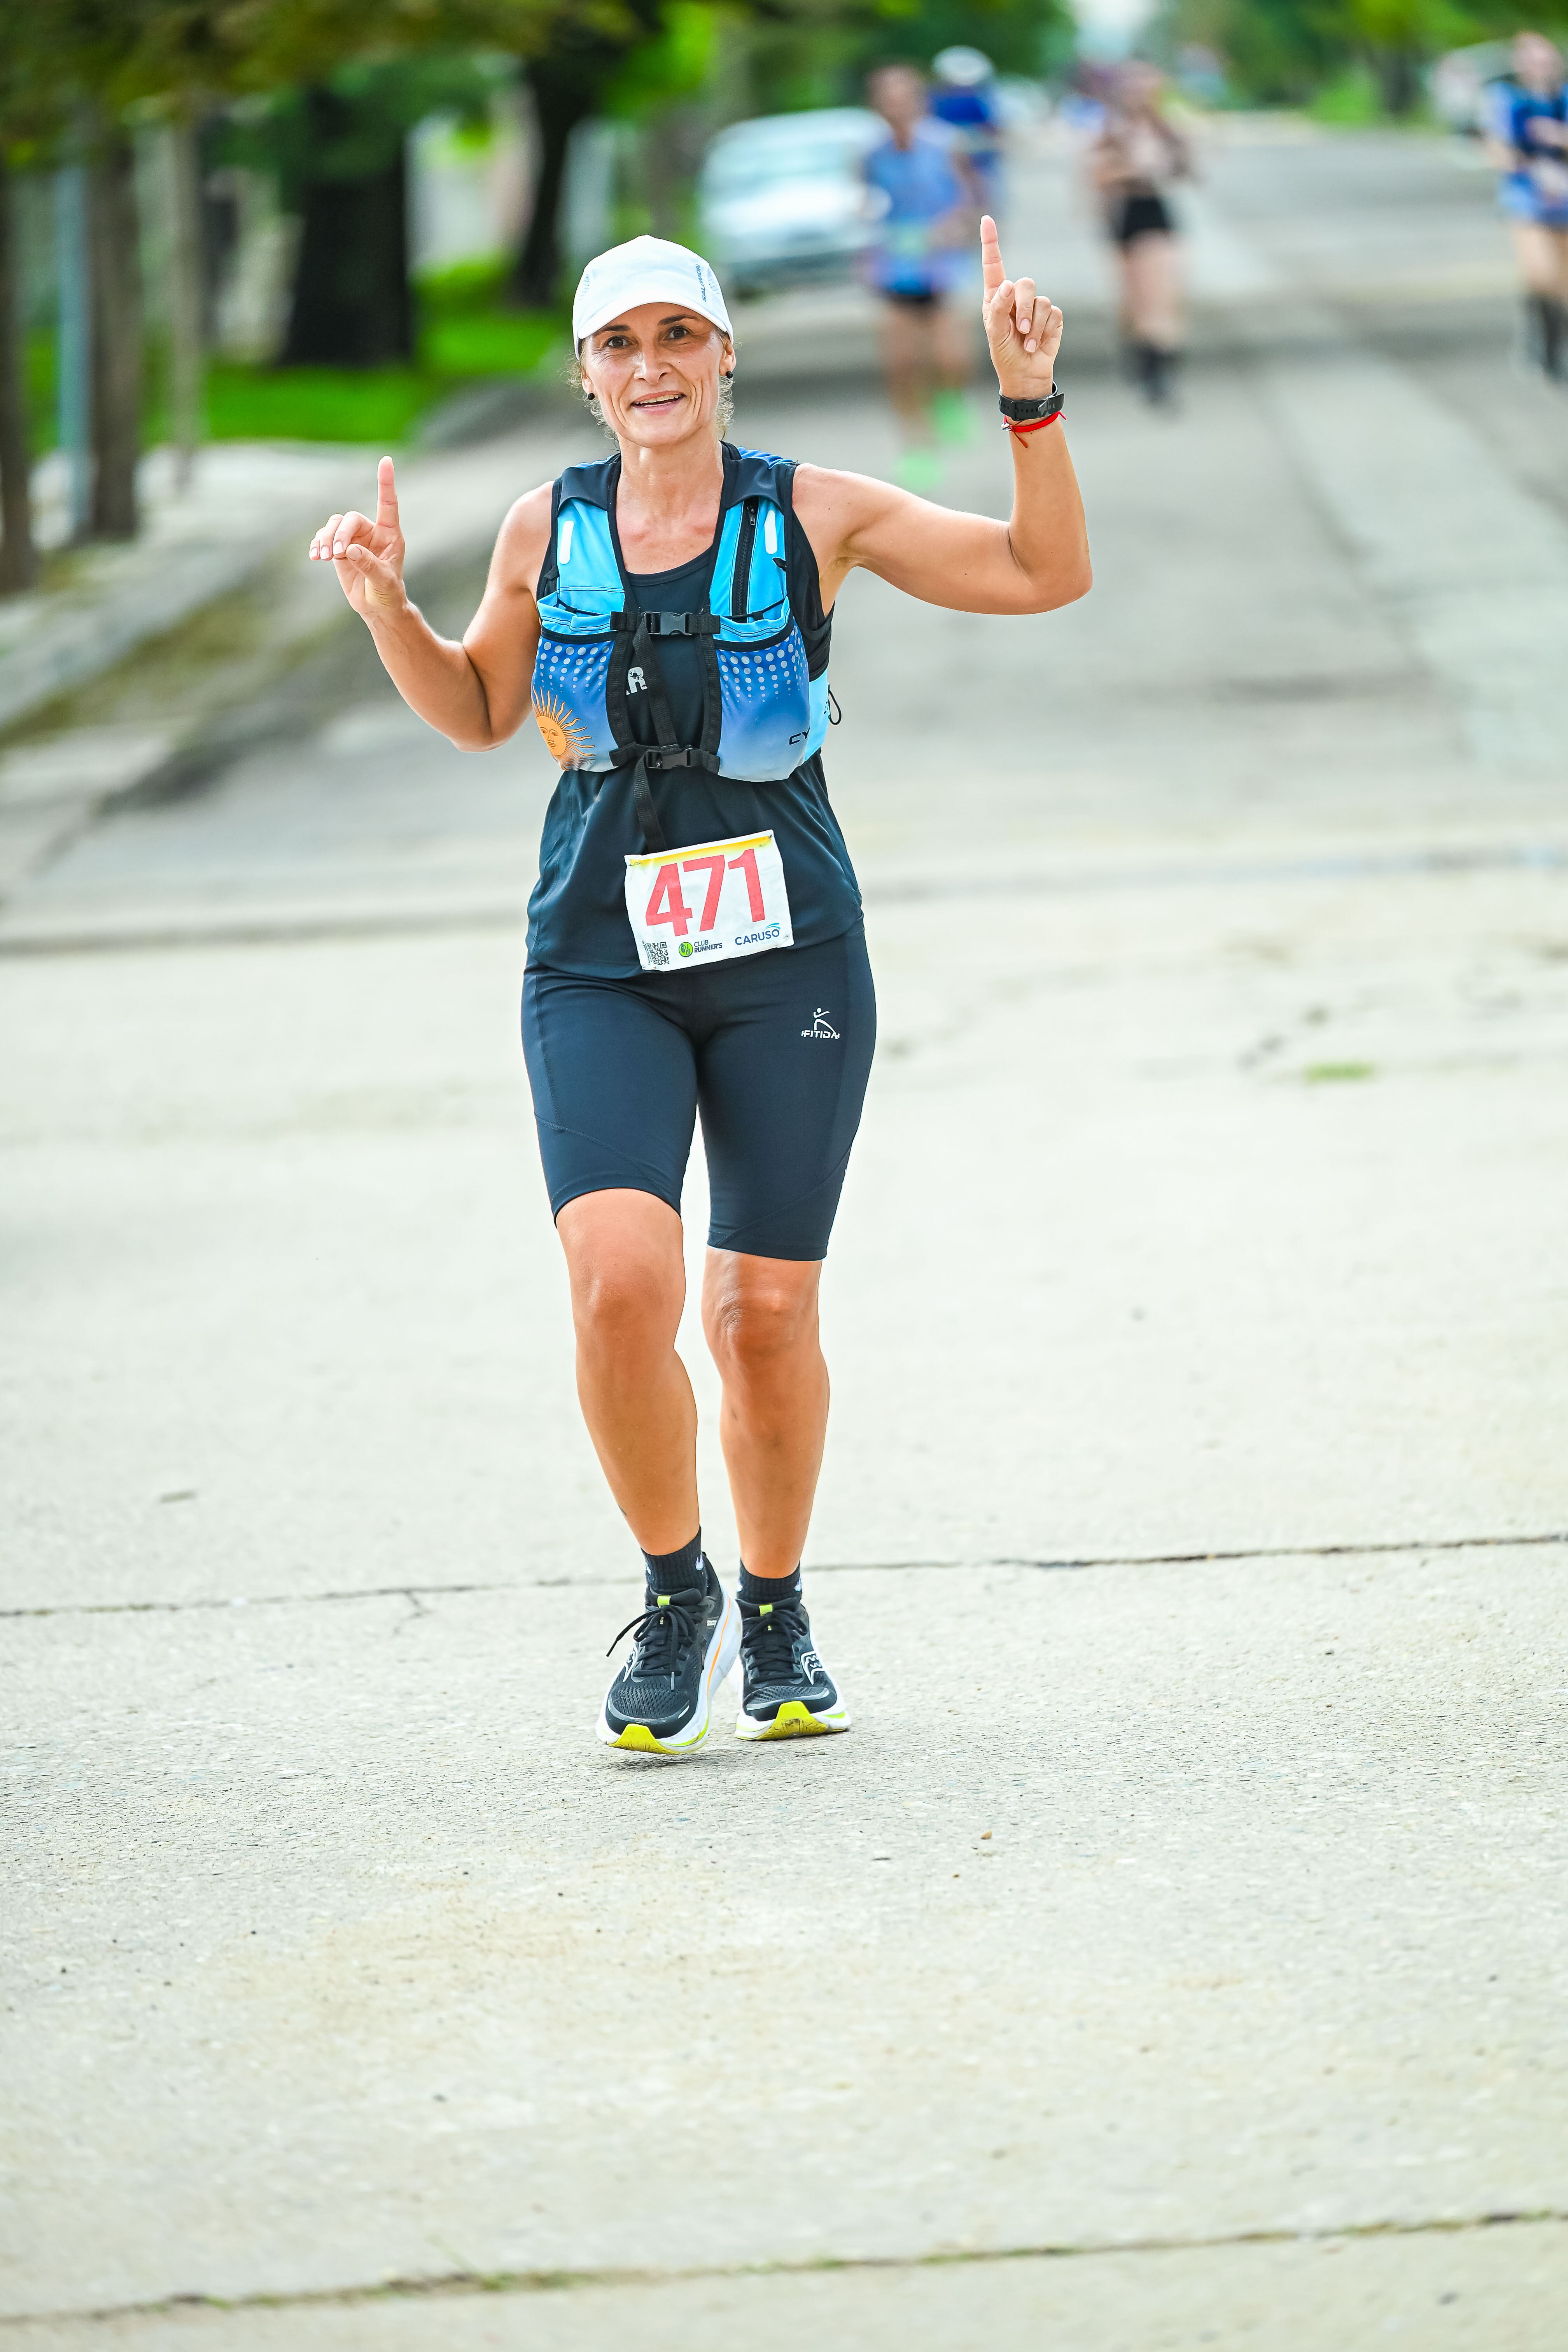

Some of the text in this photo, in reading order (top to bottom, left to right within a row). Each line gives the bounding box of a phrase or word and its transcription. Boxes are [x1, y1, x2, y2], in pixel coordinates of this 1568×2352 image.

[696, 264, 707, 302] SALOMON
[646, 849, 765, 936] 471
[694, 943, 723, 953] RUNNER'S
[735, 929, 779, 945] CARUSO
